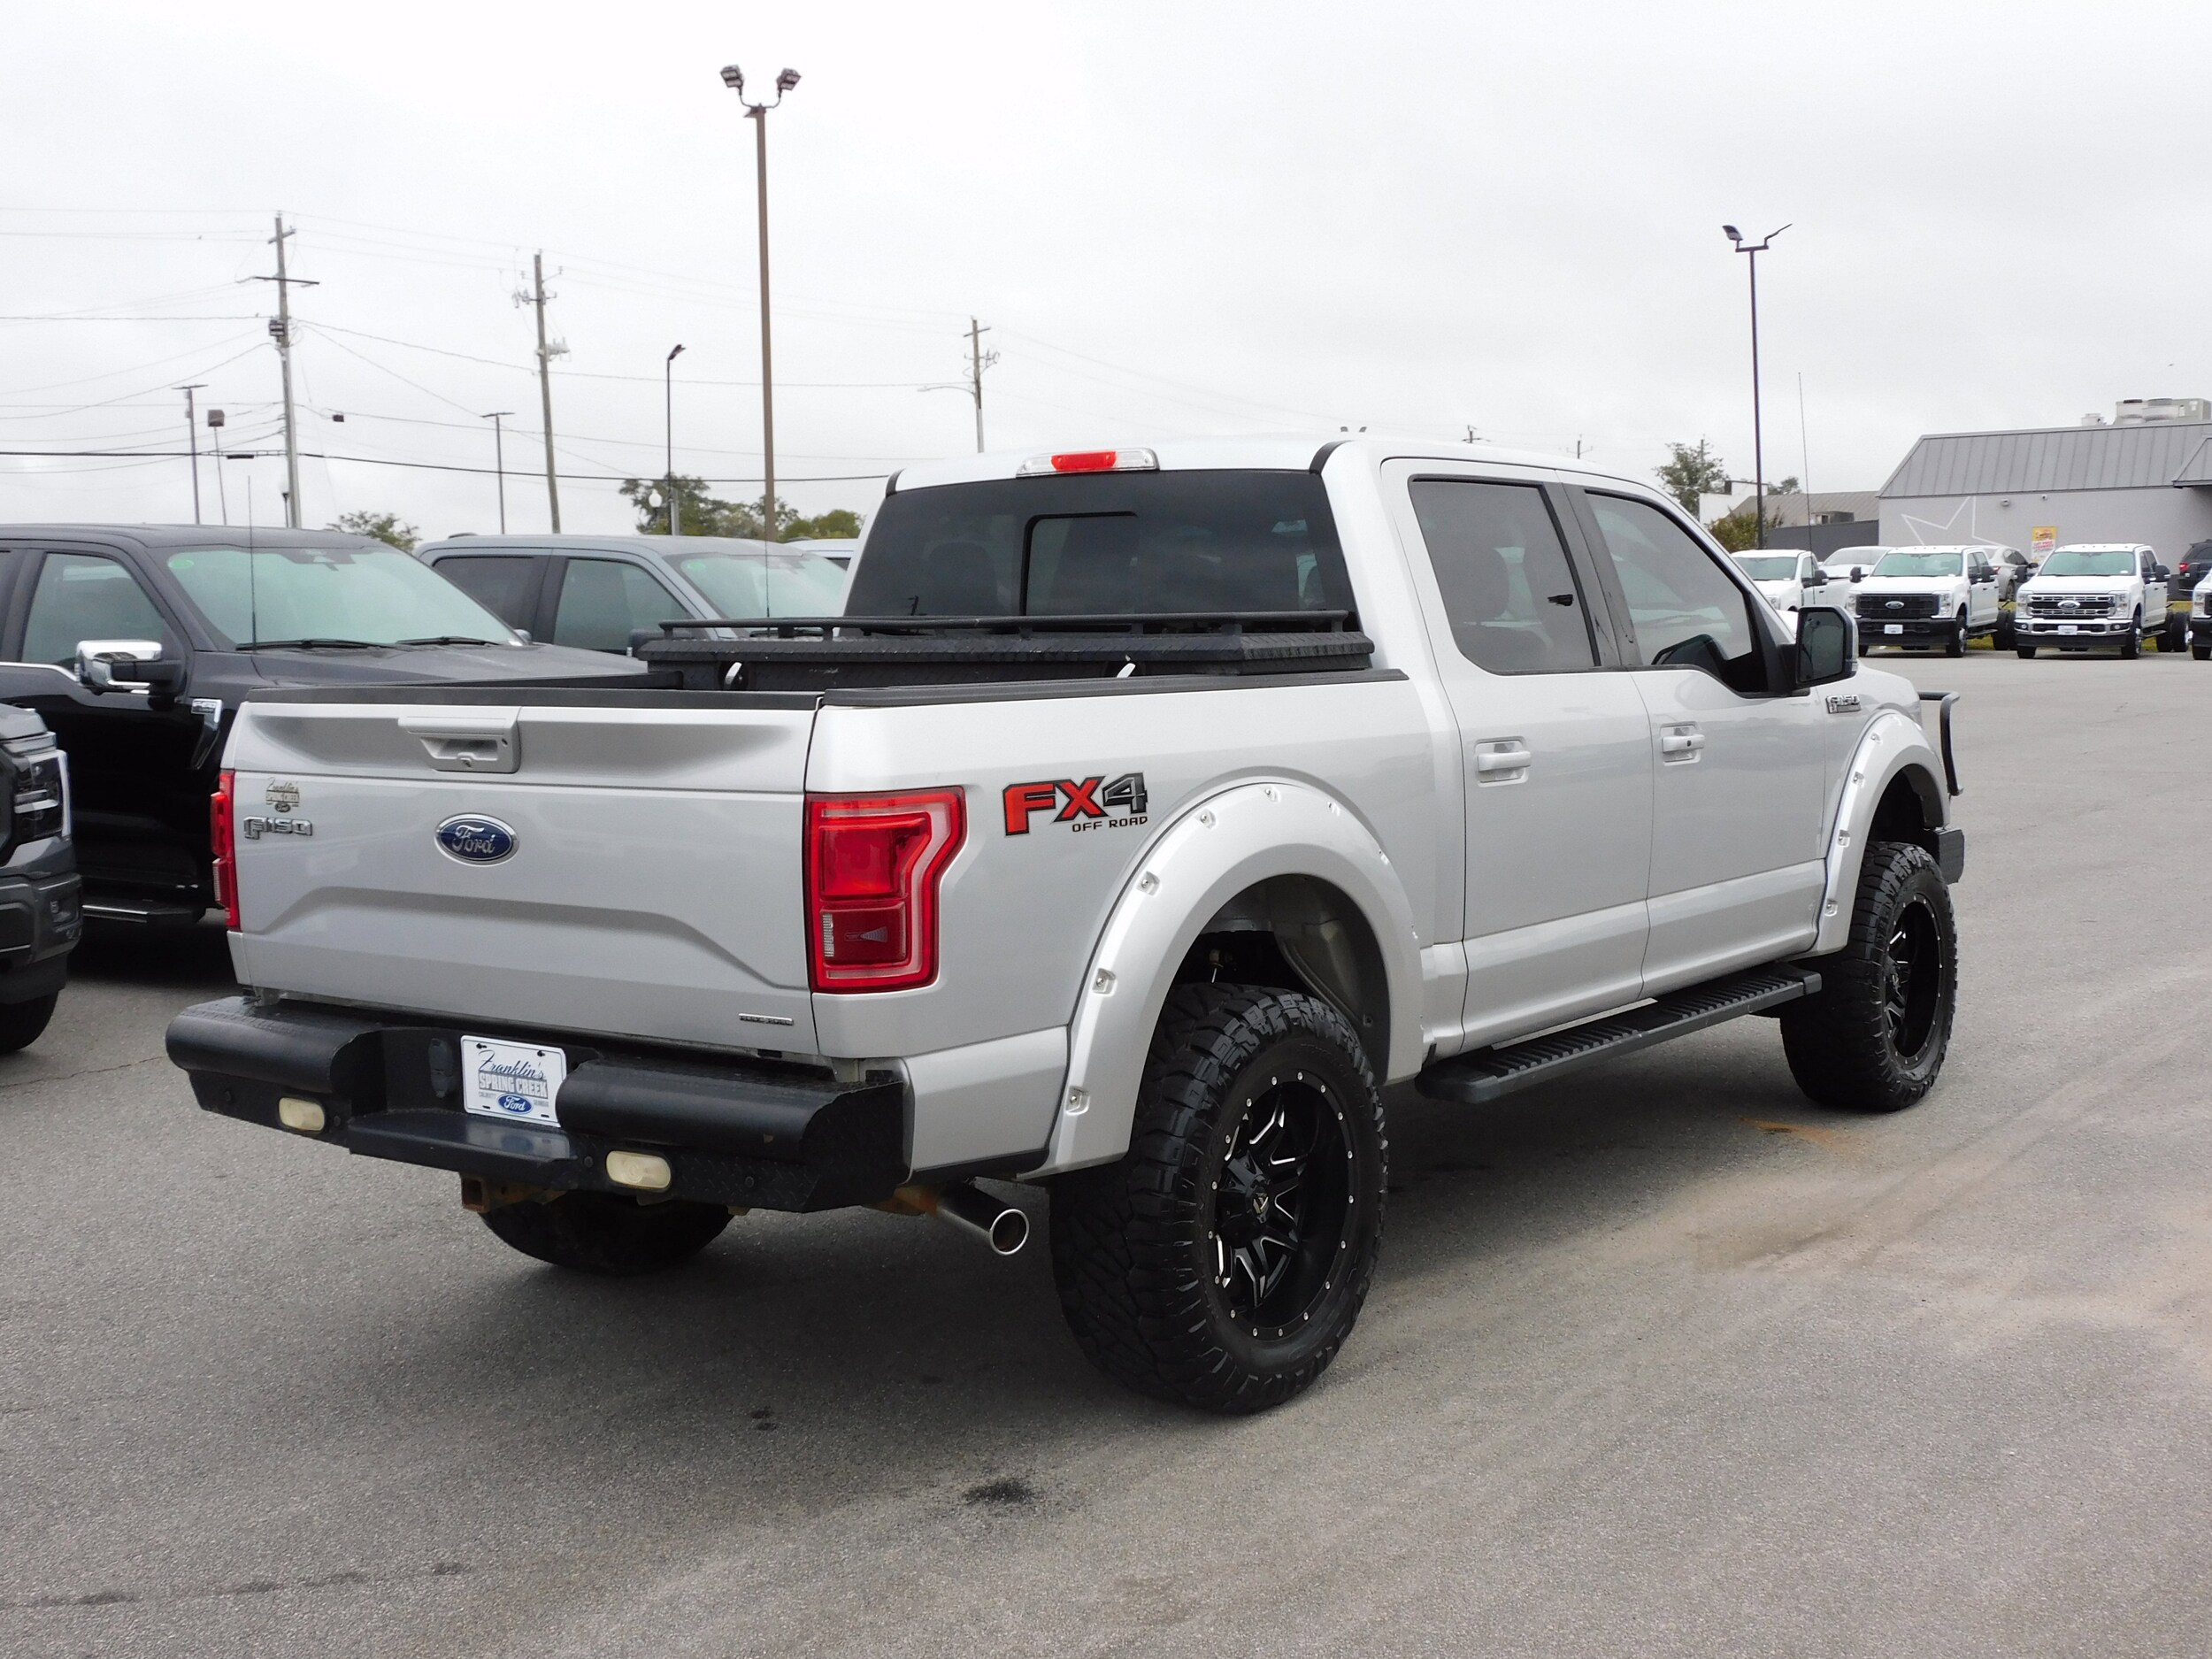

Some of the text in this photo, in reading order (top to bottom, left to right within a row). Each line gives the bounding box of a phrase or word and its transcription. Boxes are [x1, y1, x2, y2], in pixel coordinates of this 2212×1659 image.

[1002, 772, 1148, 837] FX4
[451, 824, 496, 854] Ford
[1071, 816, 1148, 833] OFF ROAD
[478, 1048, 547, 1080] Franklin's
[479, 1071, 548, 1099] SPRING CREEK
[503, 1095, 526, 1111] Ford
